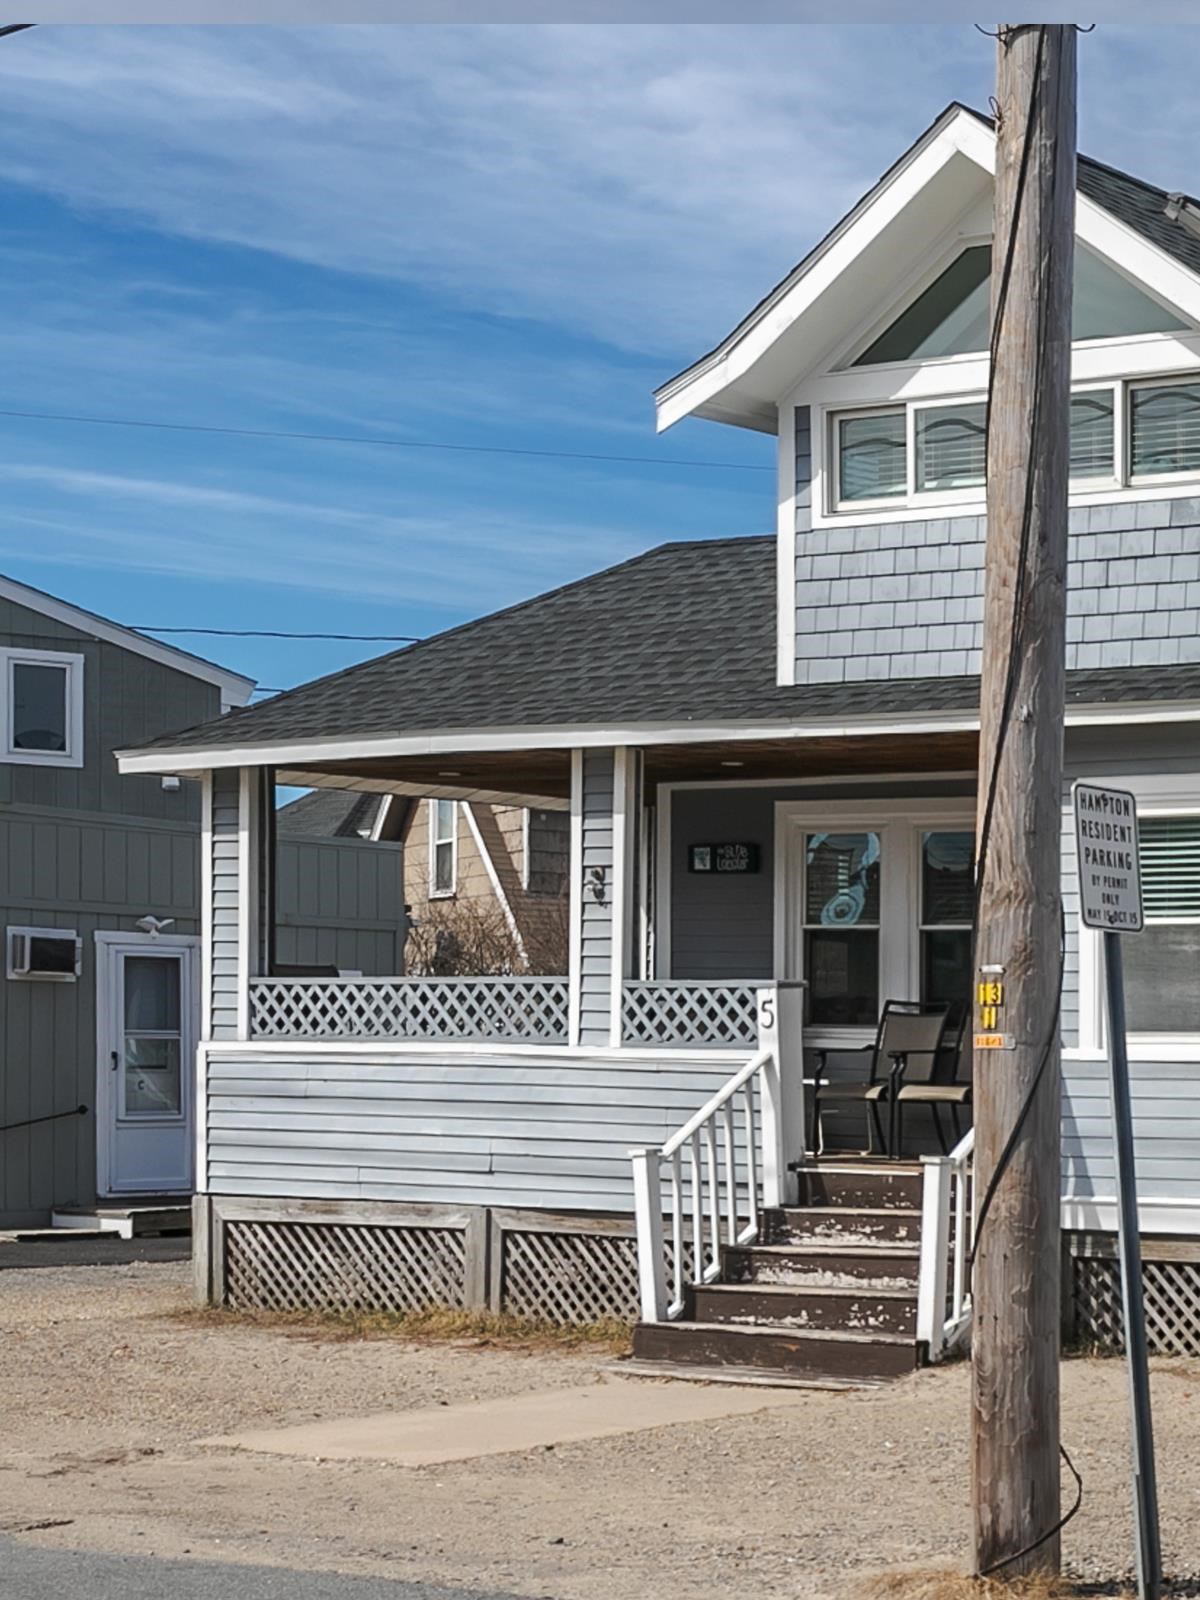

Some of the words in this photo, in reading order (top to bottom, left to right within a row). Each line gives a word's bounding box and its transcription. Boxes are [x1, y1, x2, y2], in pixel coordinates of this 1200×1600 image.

[1079, 792, 1130, 817] HAMPTON
[1081, 819, 1132, 844] RESIDENT
[1084, 847, 1132, 871] PARKING
[1091, 874, 1100, 887] BY
[1103, 875, 1128, 889] PERMIT
[1101, 892, 1120, 906] ONLY
[1087, 908, 1101, 920] MAY
[761, 998, 775, 1029] 5
